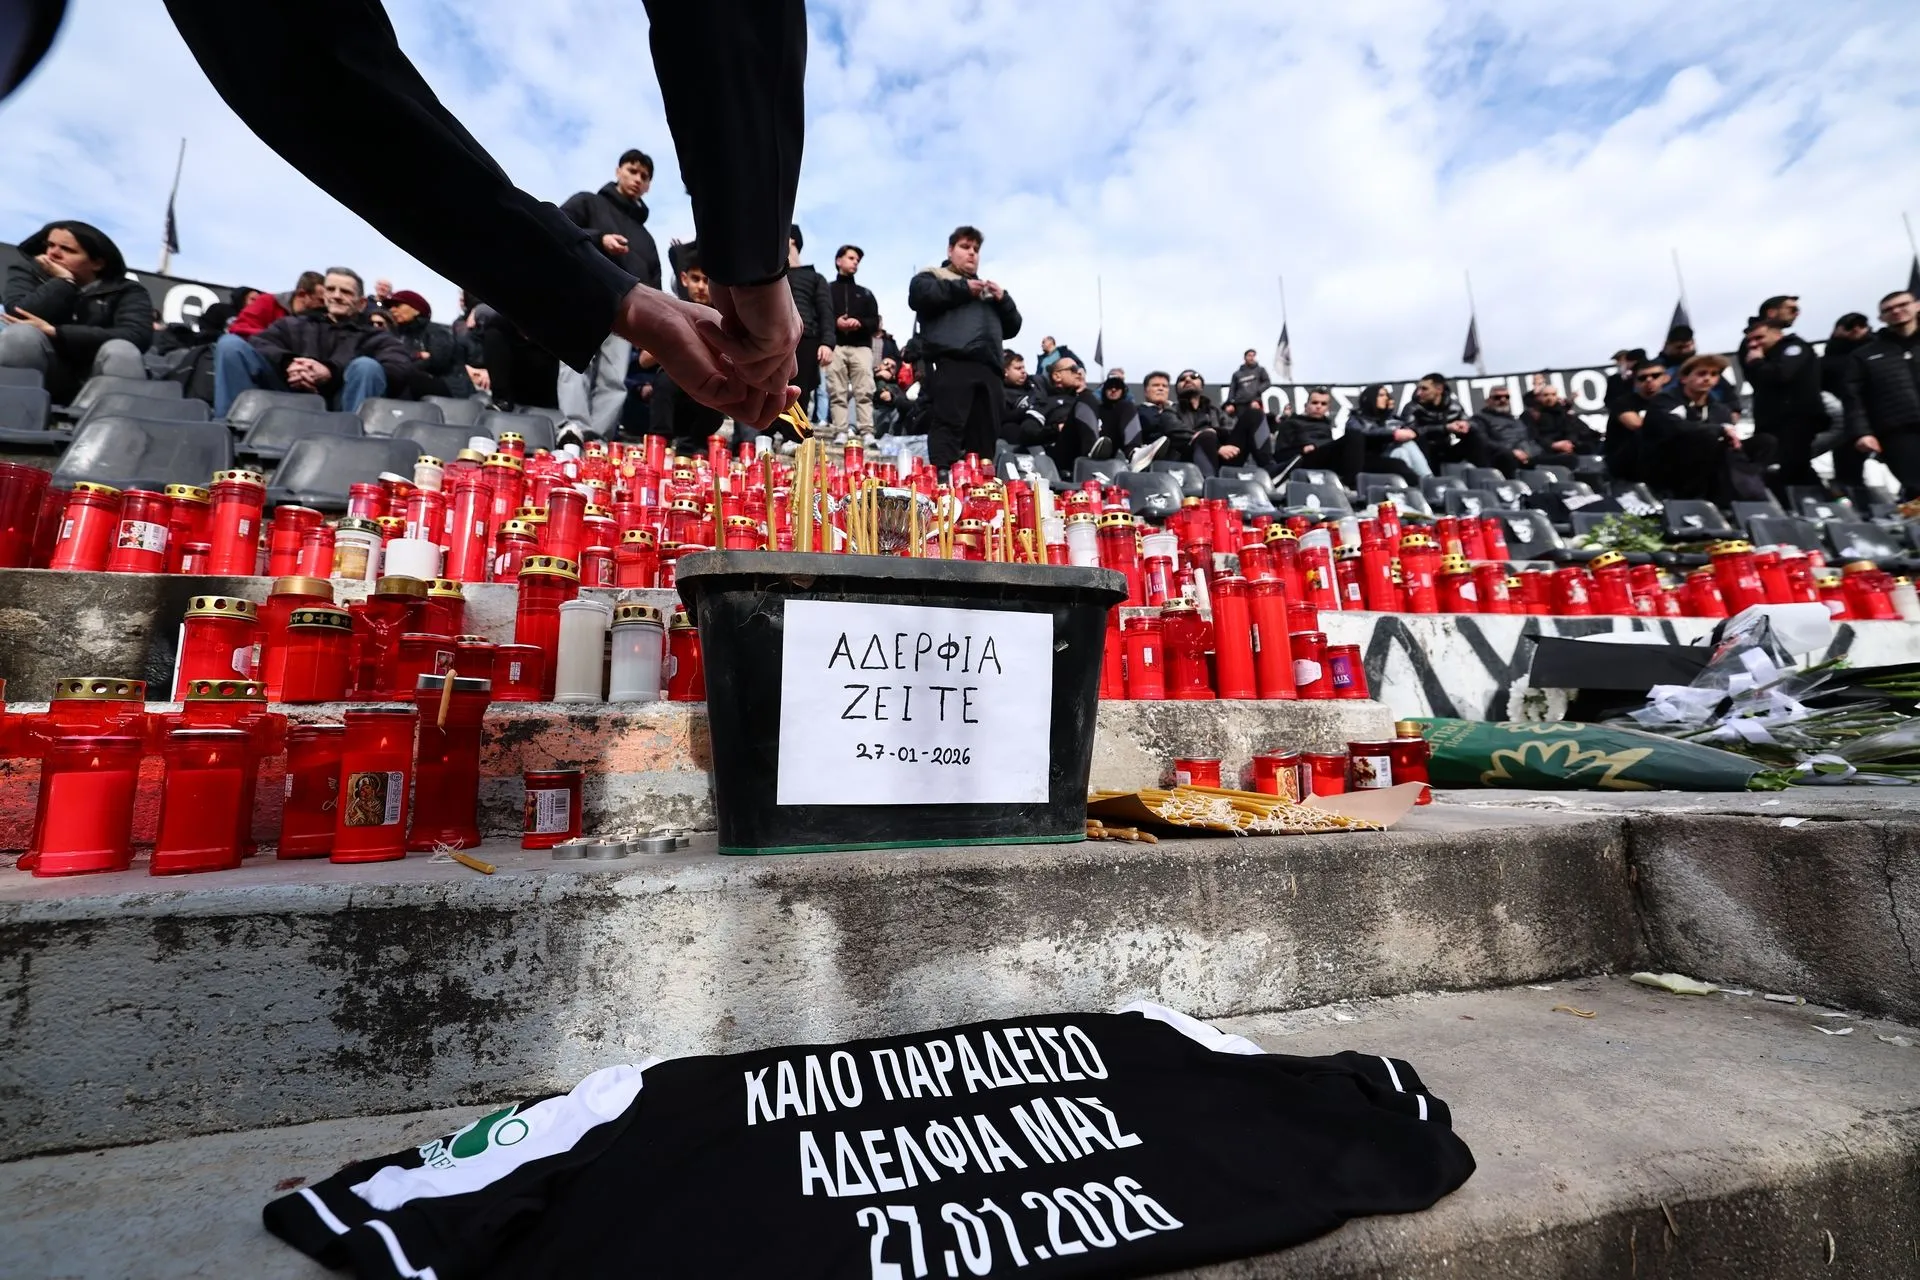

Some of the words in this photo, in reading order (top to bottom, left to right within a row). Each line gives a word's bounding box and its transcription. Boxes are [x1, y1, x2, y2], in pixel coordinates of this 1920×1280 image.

[828, 632, 1002, 675] ΑΔΕΡΦΙΑ
[1333, 674, 1351, 685] LUX
[856, 743, 971, 765] 27-01-2026
[744, 1050, 863, 1126] ΚΑΛΟ
[870, 1025, 1109, 1100] ΠΑΡΑΔΕΙΣΟ
[799, 1114, 1028, 1198] ΑΔΕΛΦΙΑ
[1009, 1096, 1143, 1164] ΜΑΣ
[856, 1175, 1184, 1280] 27.01.2026
